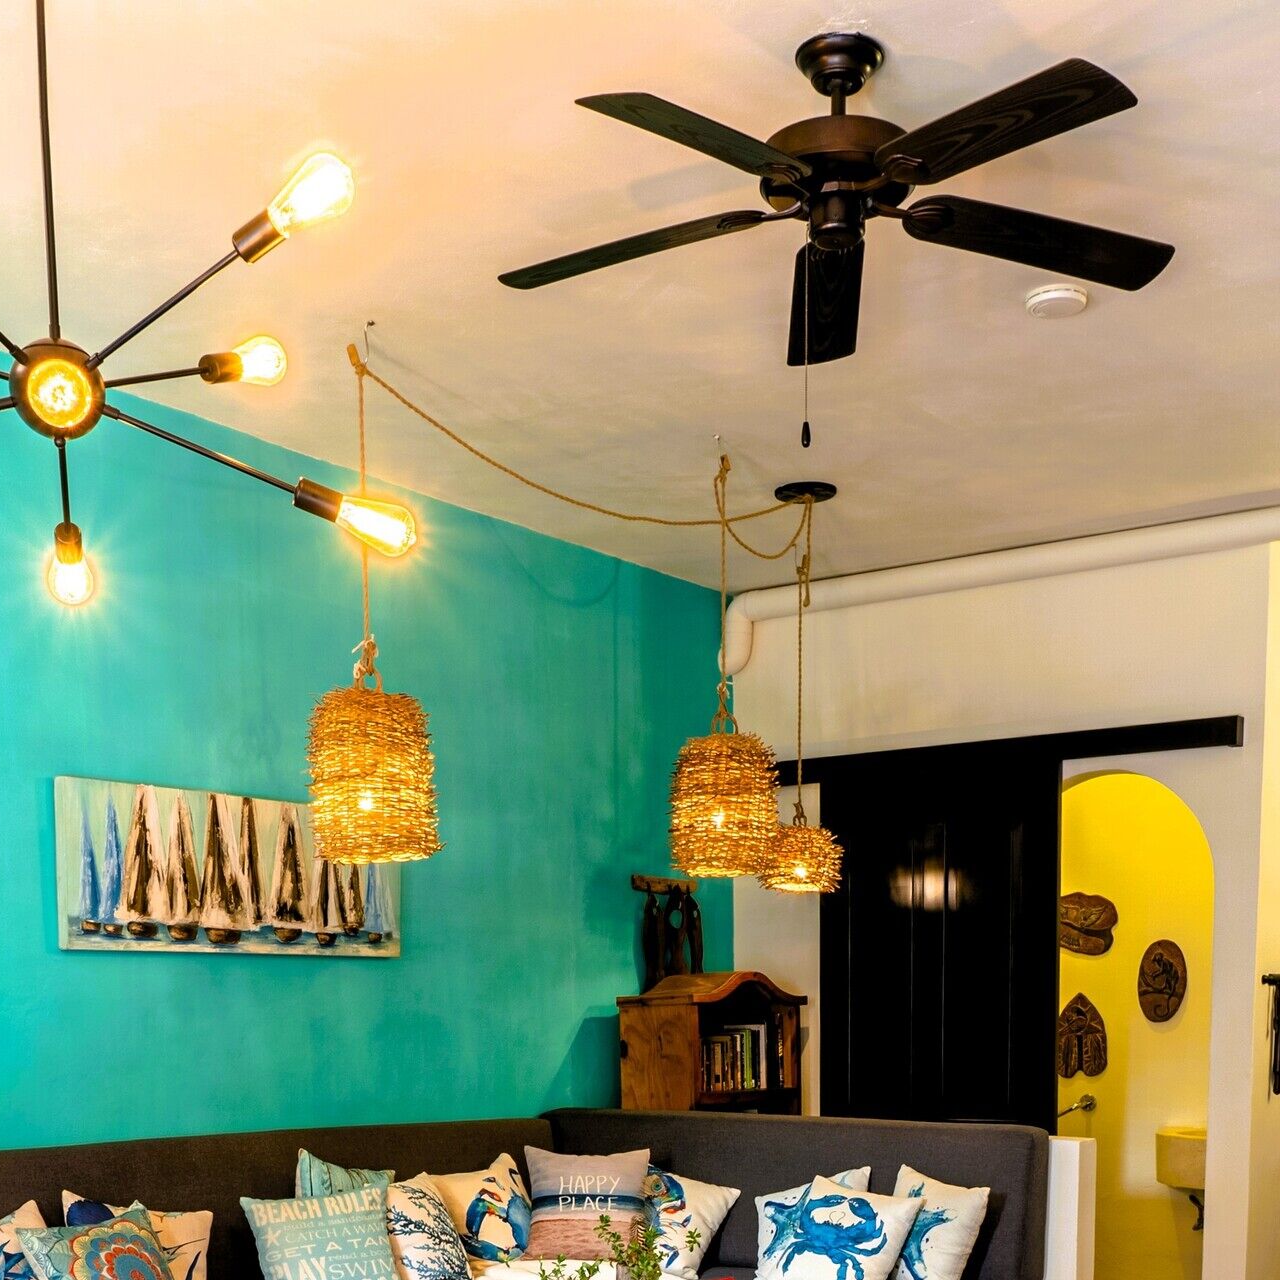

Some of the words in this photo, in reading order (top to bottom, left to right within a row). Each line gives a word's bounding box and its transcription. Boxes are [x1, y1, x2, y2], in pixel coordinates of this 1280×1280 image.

[559, 1175, 620, 1195] HAPPY
[251, 1198, 322, 1227] BEACH
[323, 1188, 381, 1216] RULES
[558, 1195, 619, 1212] PLACE
[284, 1227, 338, 1243] CATCH
[341, 1226, 352, 1237] A
[265, 1244, 317, 1262] GET
[325, 1241, 342, 1252] A
[346, 1235, 390, 1249] TAN
[328, 1257, 397, 1280] SWIM
